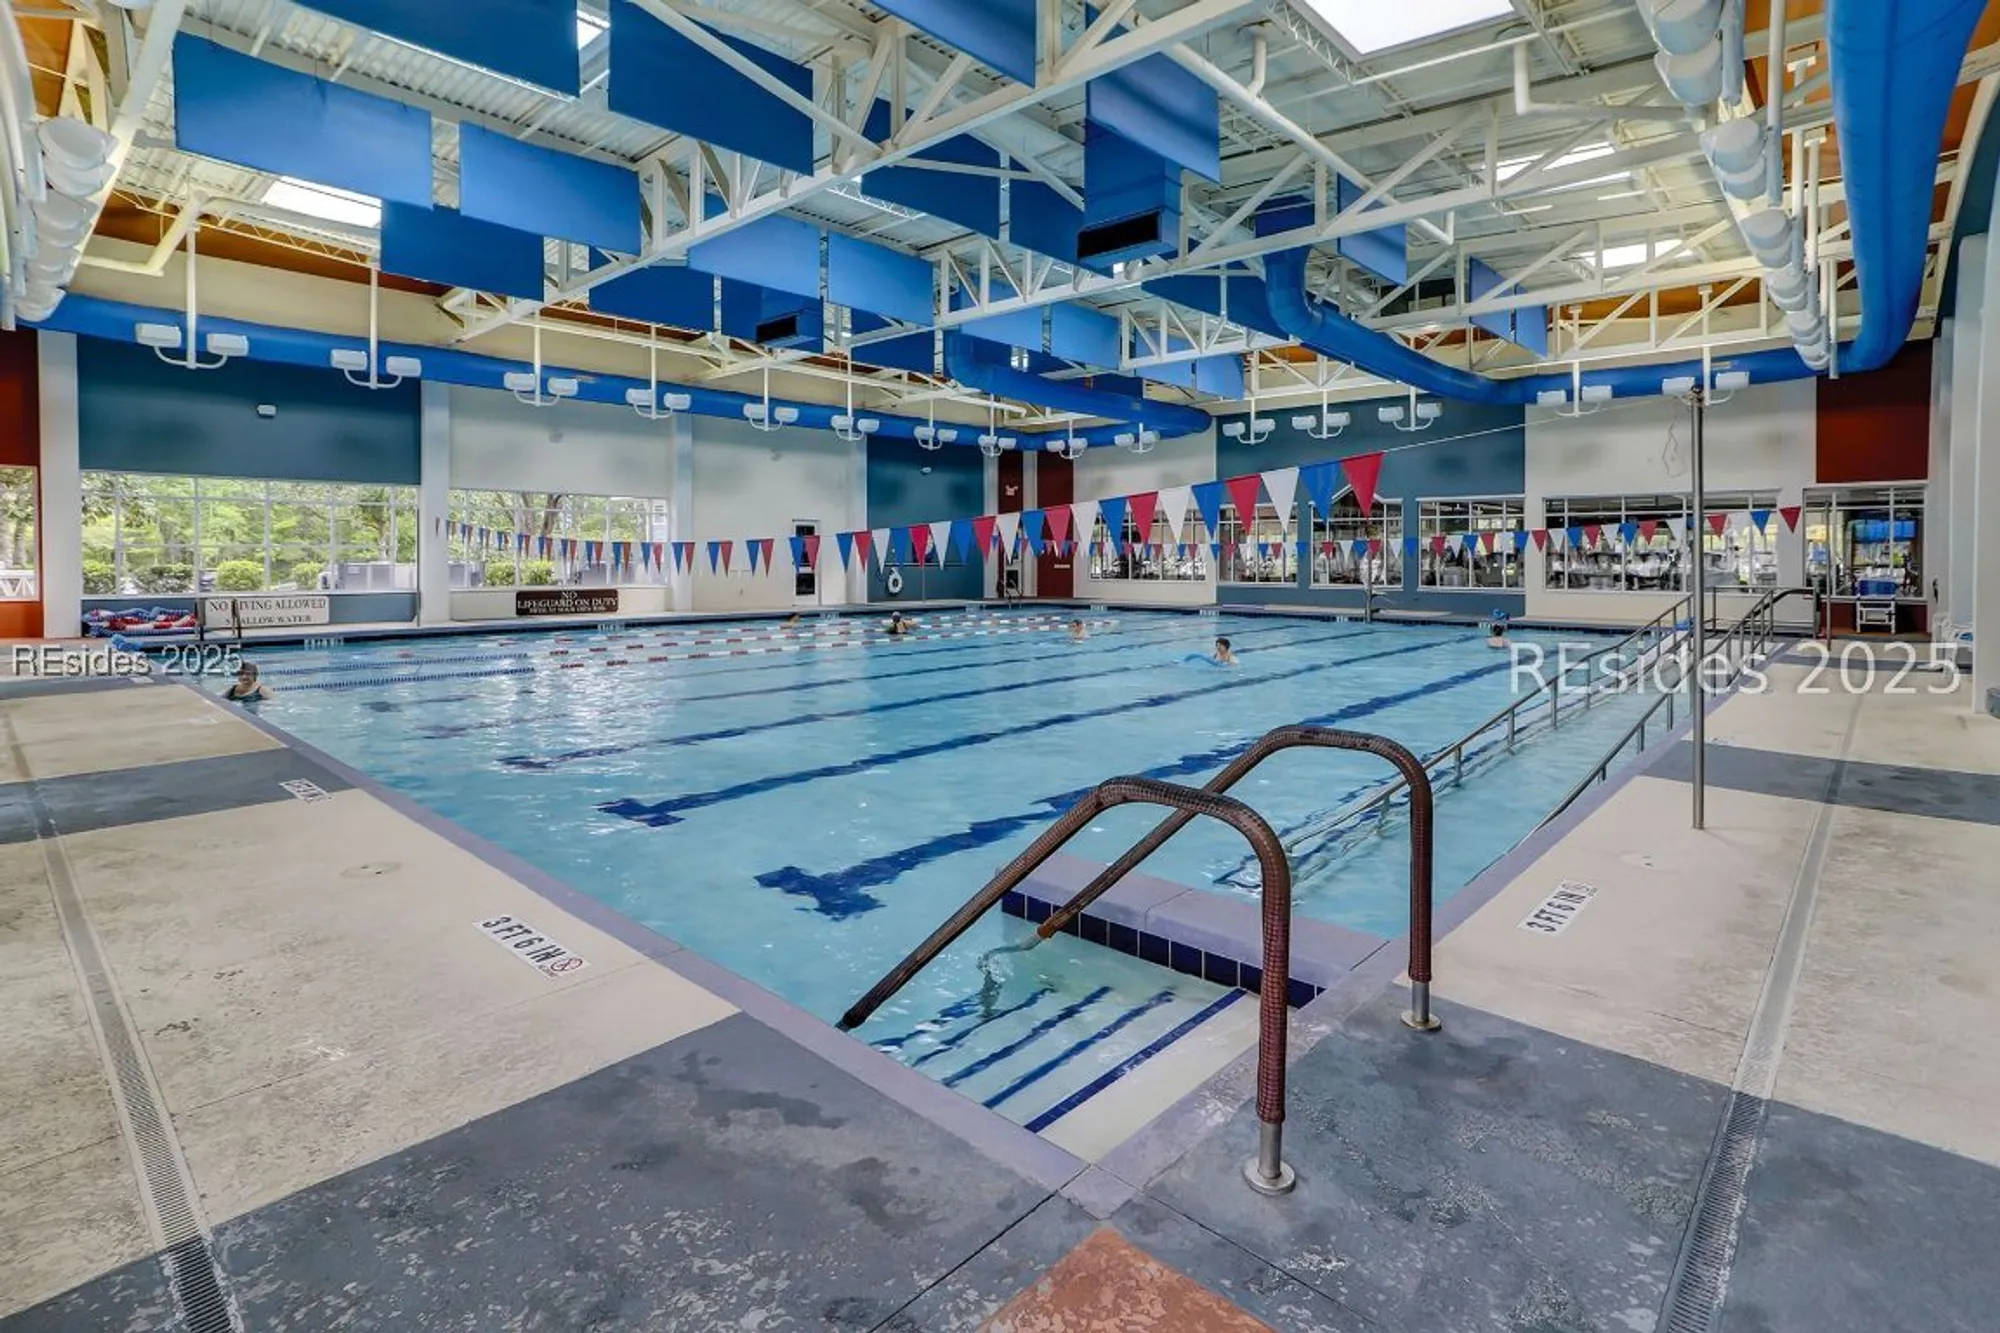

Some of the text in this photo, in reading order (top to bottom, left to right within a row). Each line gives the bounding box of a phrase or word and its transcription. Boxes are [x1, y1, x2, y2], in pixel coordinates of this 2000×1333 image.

[562, 591, 577, 599] NO
[210, 599, 326, 611] NO IVING ALLOWED
[518, 599, 573, 608] LIFEGUARD
[592, 597, 617, 606] DUTY
[226, 614, 312, 626] SALLOW WATER
